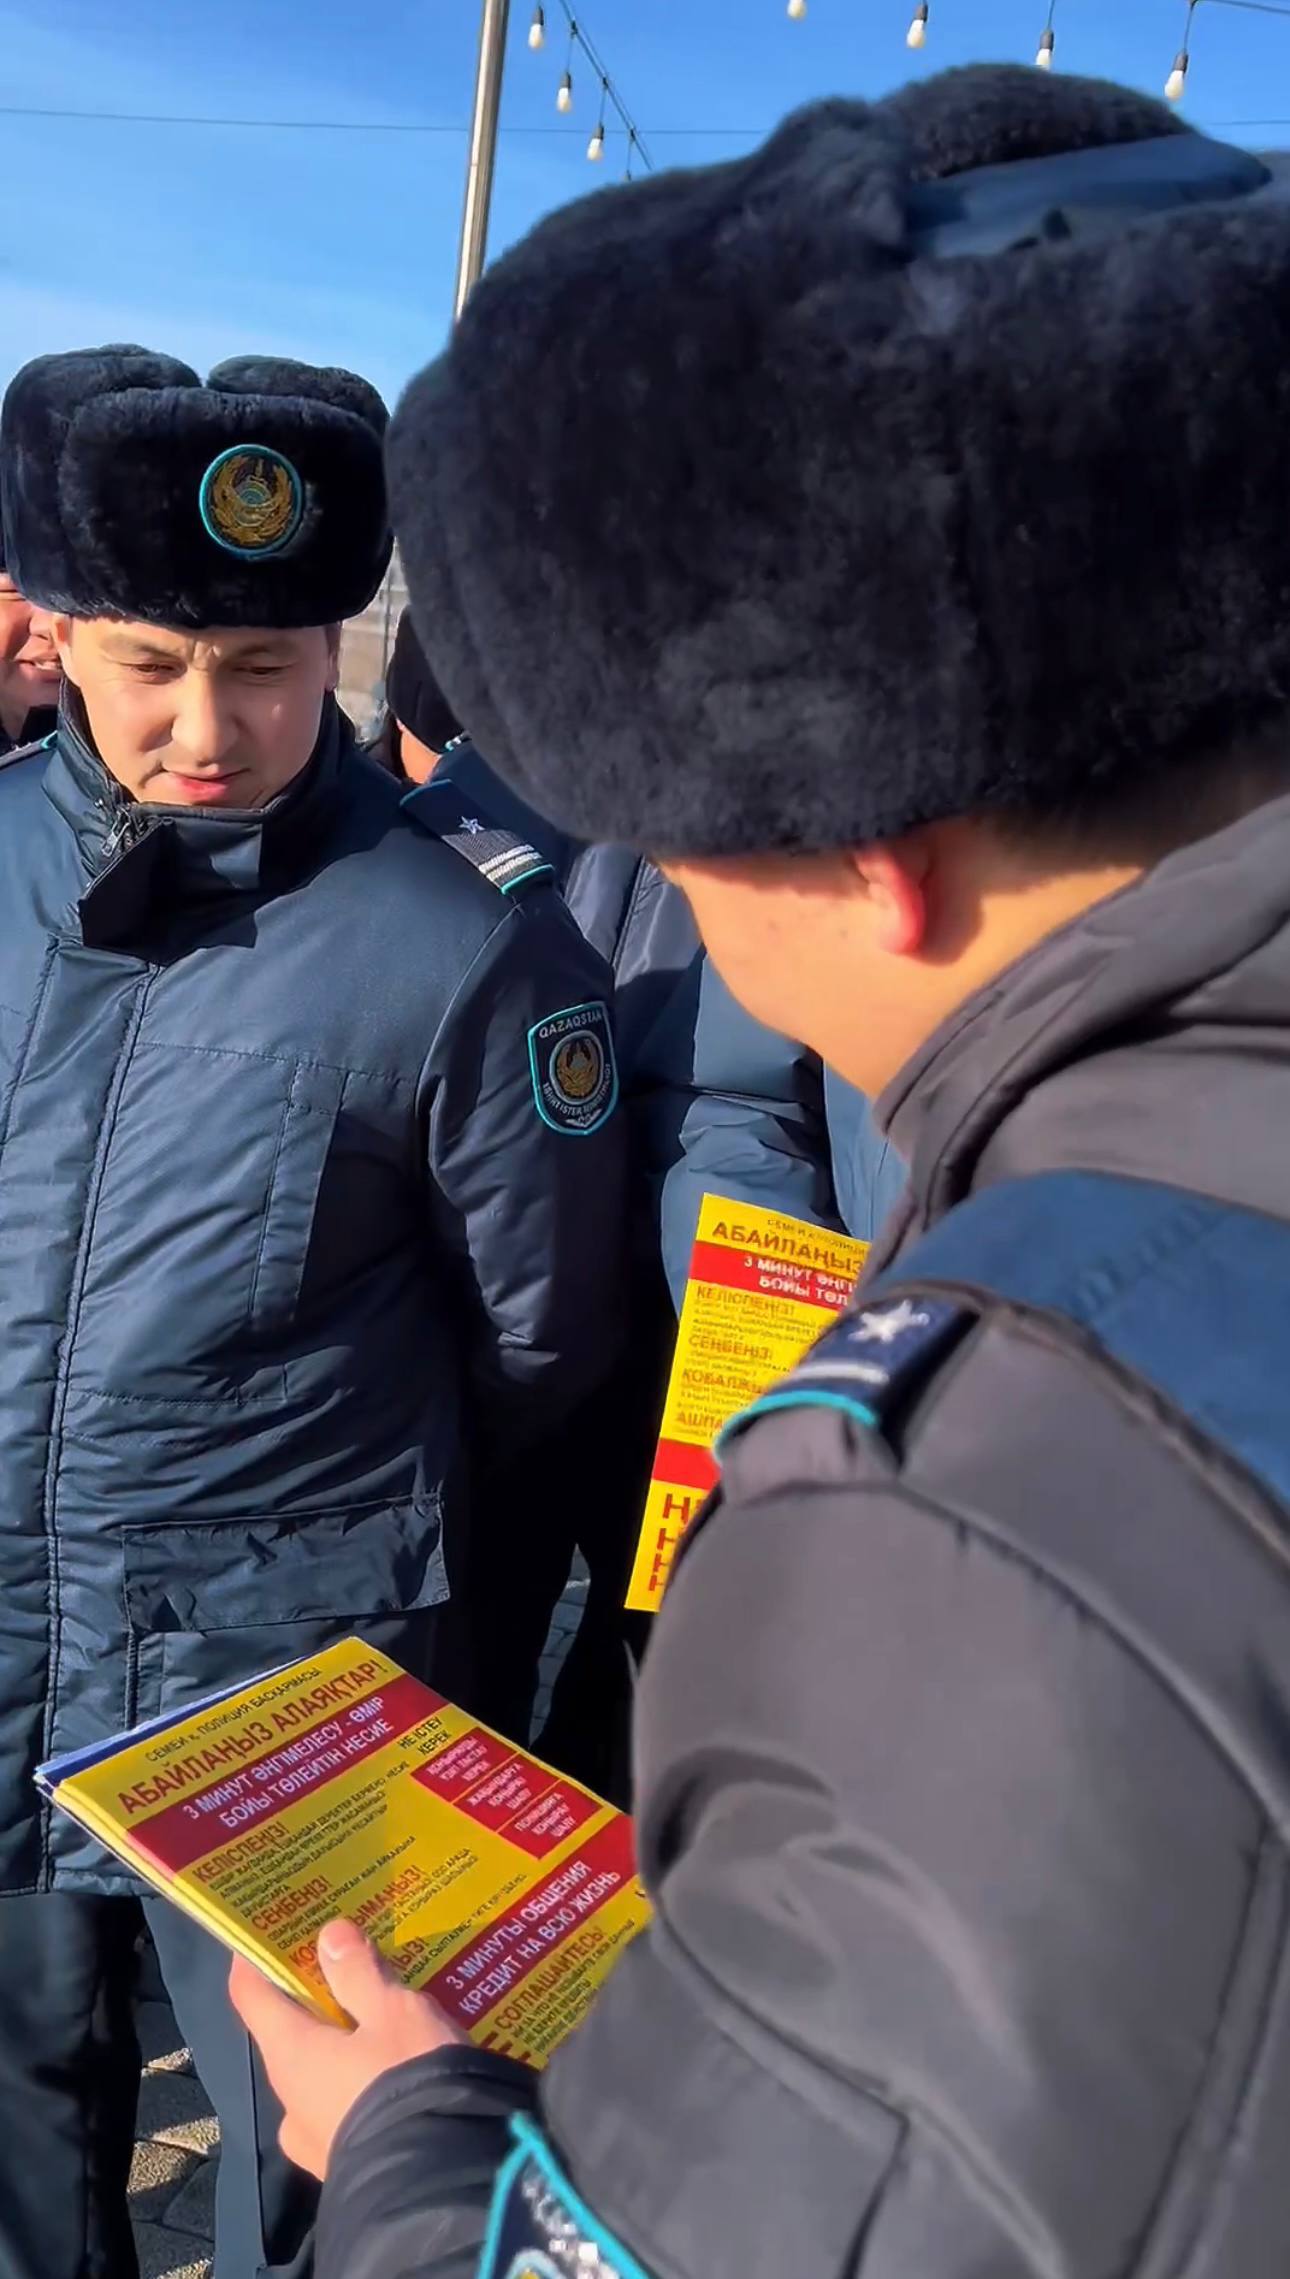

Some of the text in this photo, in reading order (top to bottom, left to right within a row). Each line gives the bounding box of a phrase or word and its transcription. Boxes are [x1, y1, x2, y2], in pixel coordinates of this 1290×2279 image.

[539, 1009, 603, 1039] QAZAQSTAN
[757, 1257, 813, 1280] МИНУТ
[112, 1660, 389, 1814] АБАЙЛАҢЫЗ АЛАЯҚТАР!
[196, 1703, 253, 1734] ПОЛИЦИЯ
[396, 1735, 416, 1748] НЕ
[416, 1730, 453, 1754] КЕРЕК
[182, 1805, 200, 1818] 3
[194, 1773, 256, 1811] МИНУТ
[248, 1721, 347, 1780] ӘҢГІМЕЛЕСУ
[346, 1696, 389, 1722] ӨМІР
[218, 1718, 394, 1827] БОЙЫ ТӨЛЕЙТІН НЕСИЕ
[445, 1974, 464, 1989] 3
[455, 1918, 527, 1978] МИНУТЫ
[519, 1861, 594, 1923] ОБЩЕНИЯ
[458, 1956, 524, 2014] КРЕДИТ
[517, 1937, 544, 1959] НА
[538, 1907, 576, 1939] ВСЮ
[569, 1867, 621, 1912] ЖИЗНЬ
